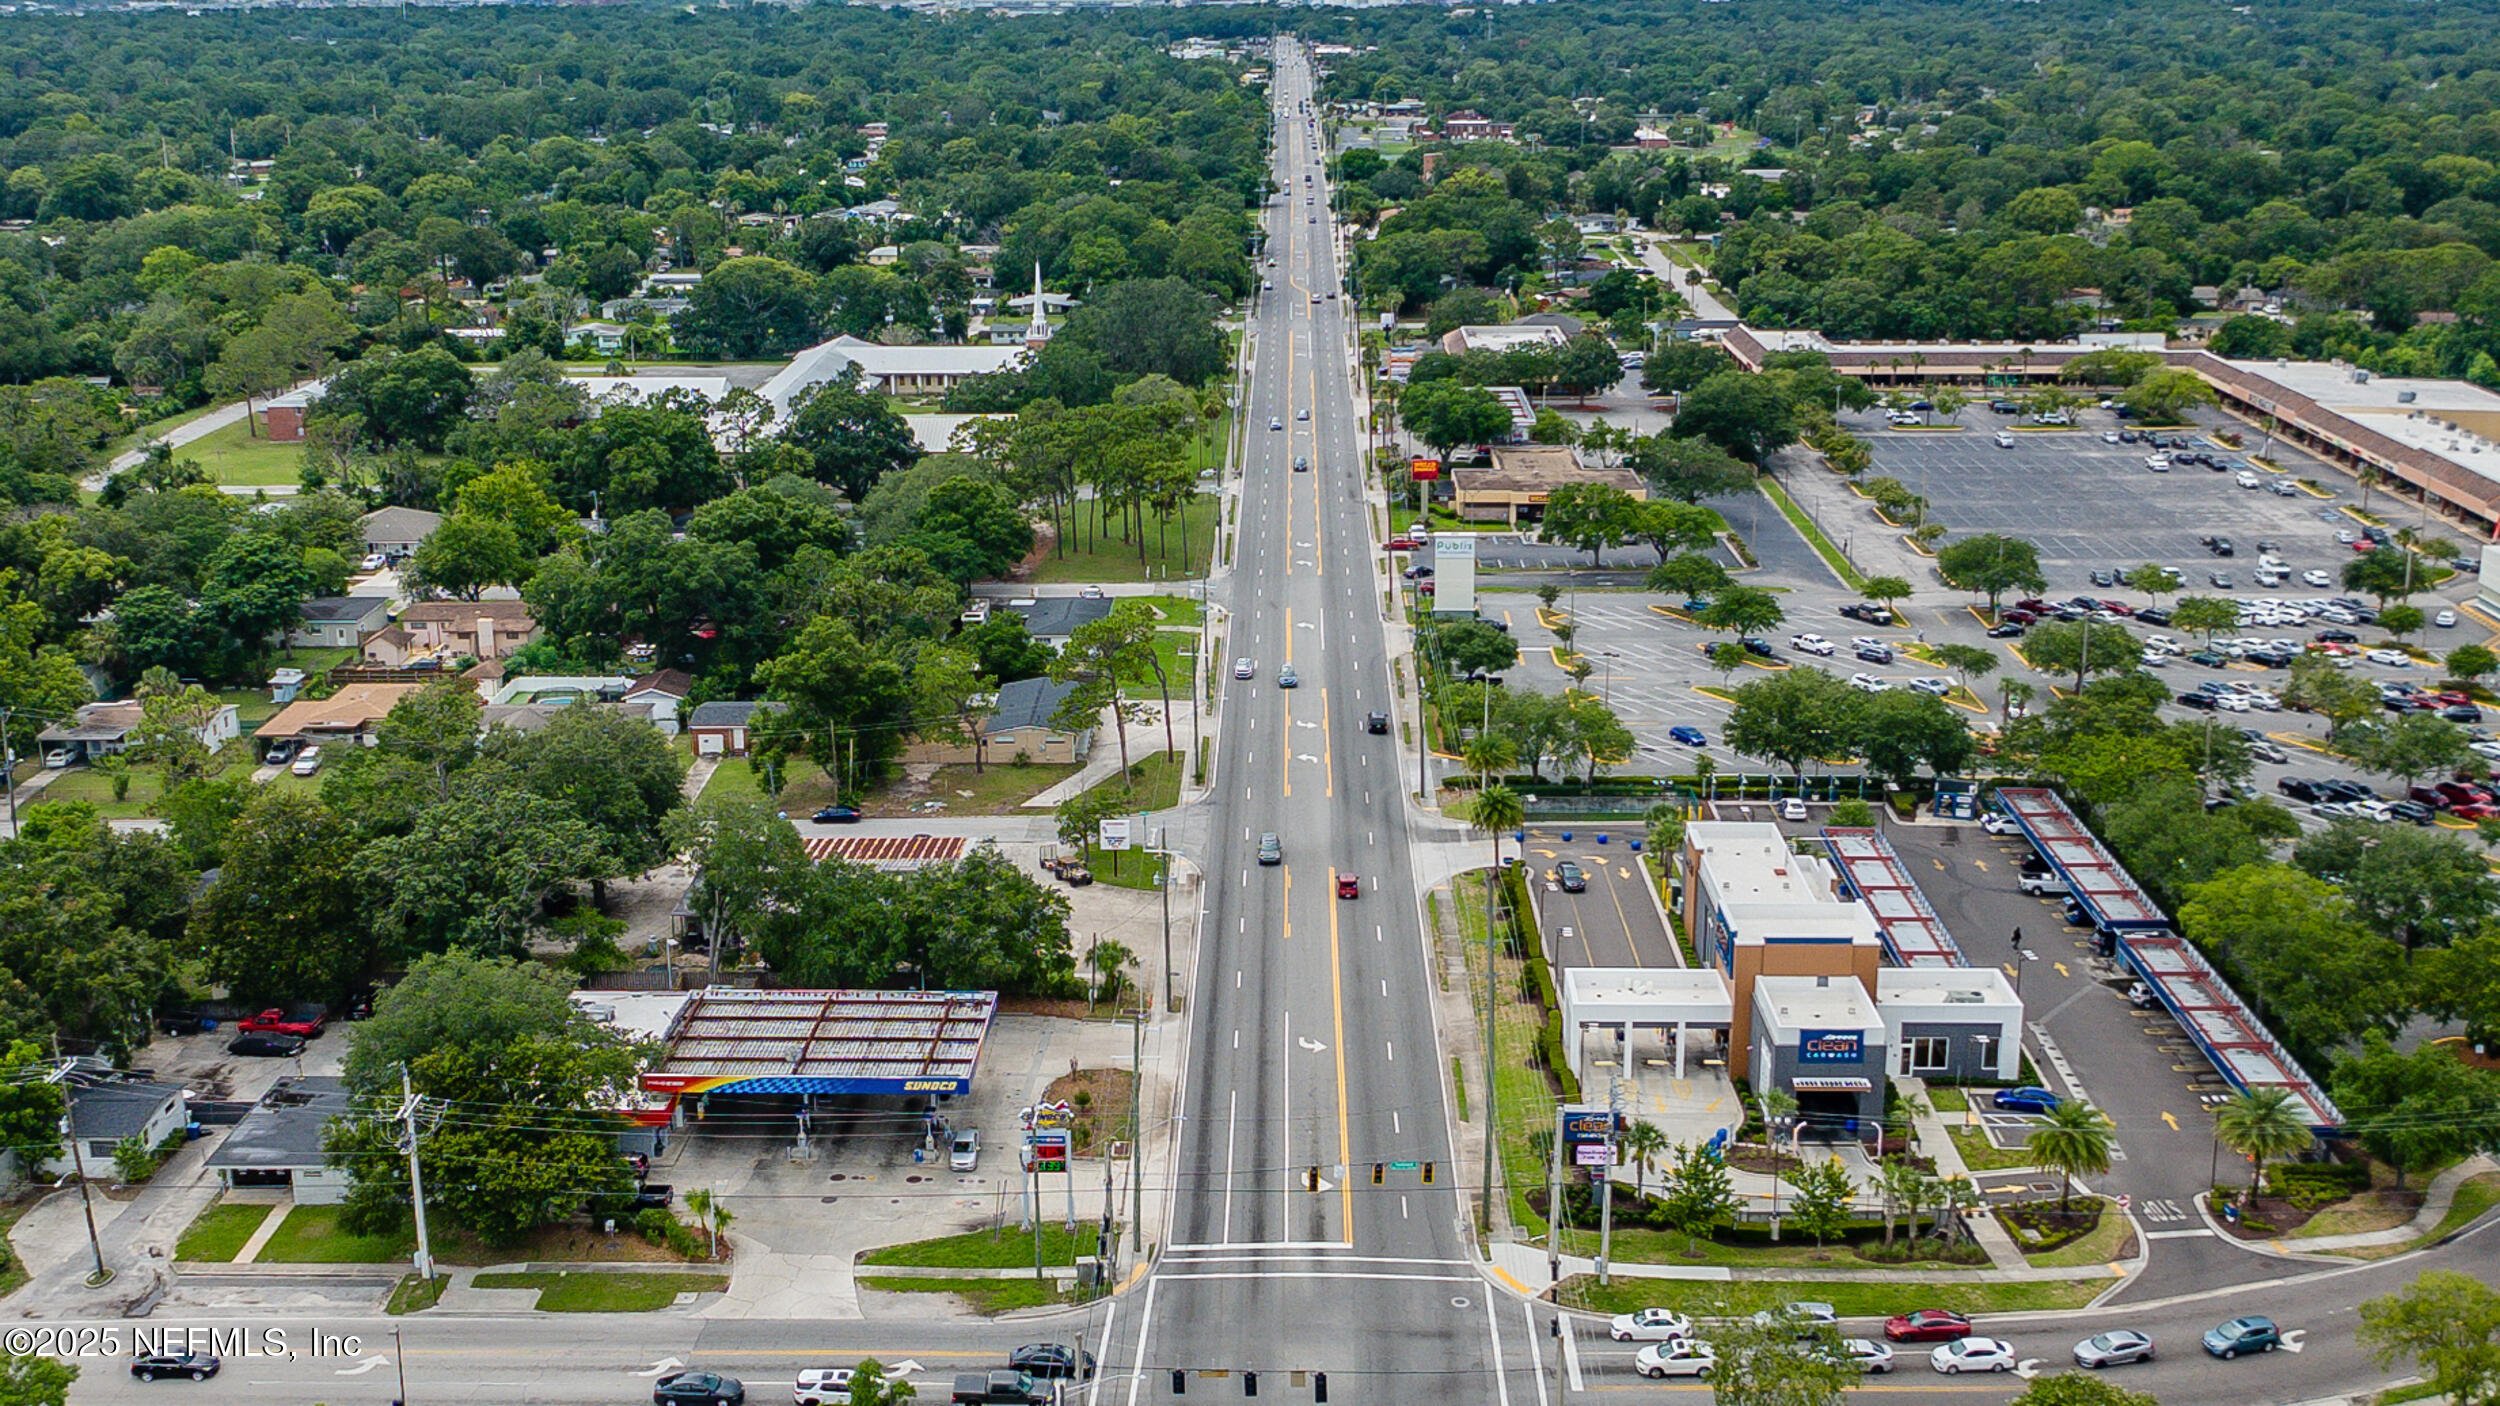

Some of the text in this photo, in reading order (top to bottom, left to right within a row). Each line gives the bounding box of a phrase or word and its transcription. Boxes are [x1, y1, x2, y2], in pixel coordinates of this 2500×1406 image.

[1807, 1039, 1857, 1051] clean
[904, 1081, 957, 1091] SUNOCO
[2140, 1199, 2187, 1222] STOP
